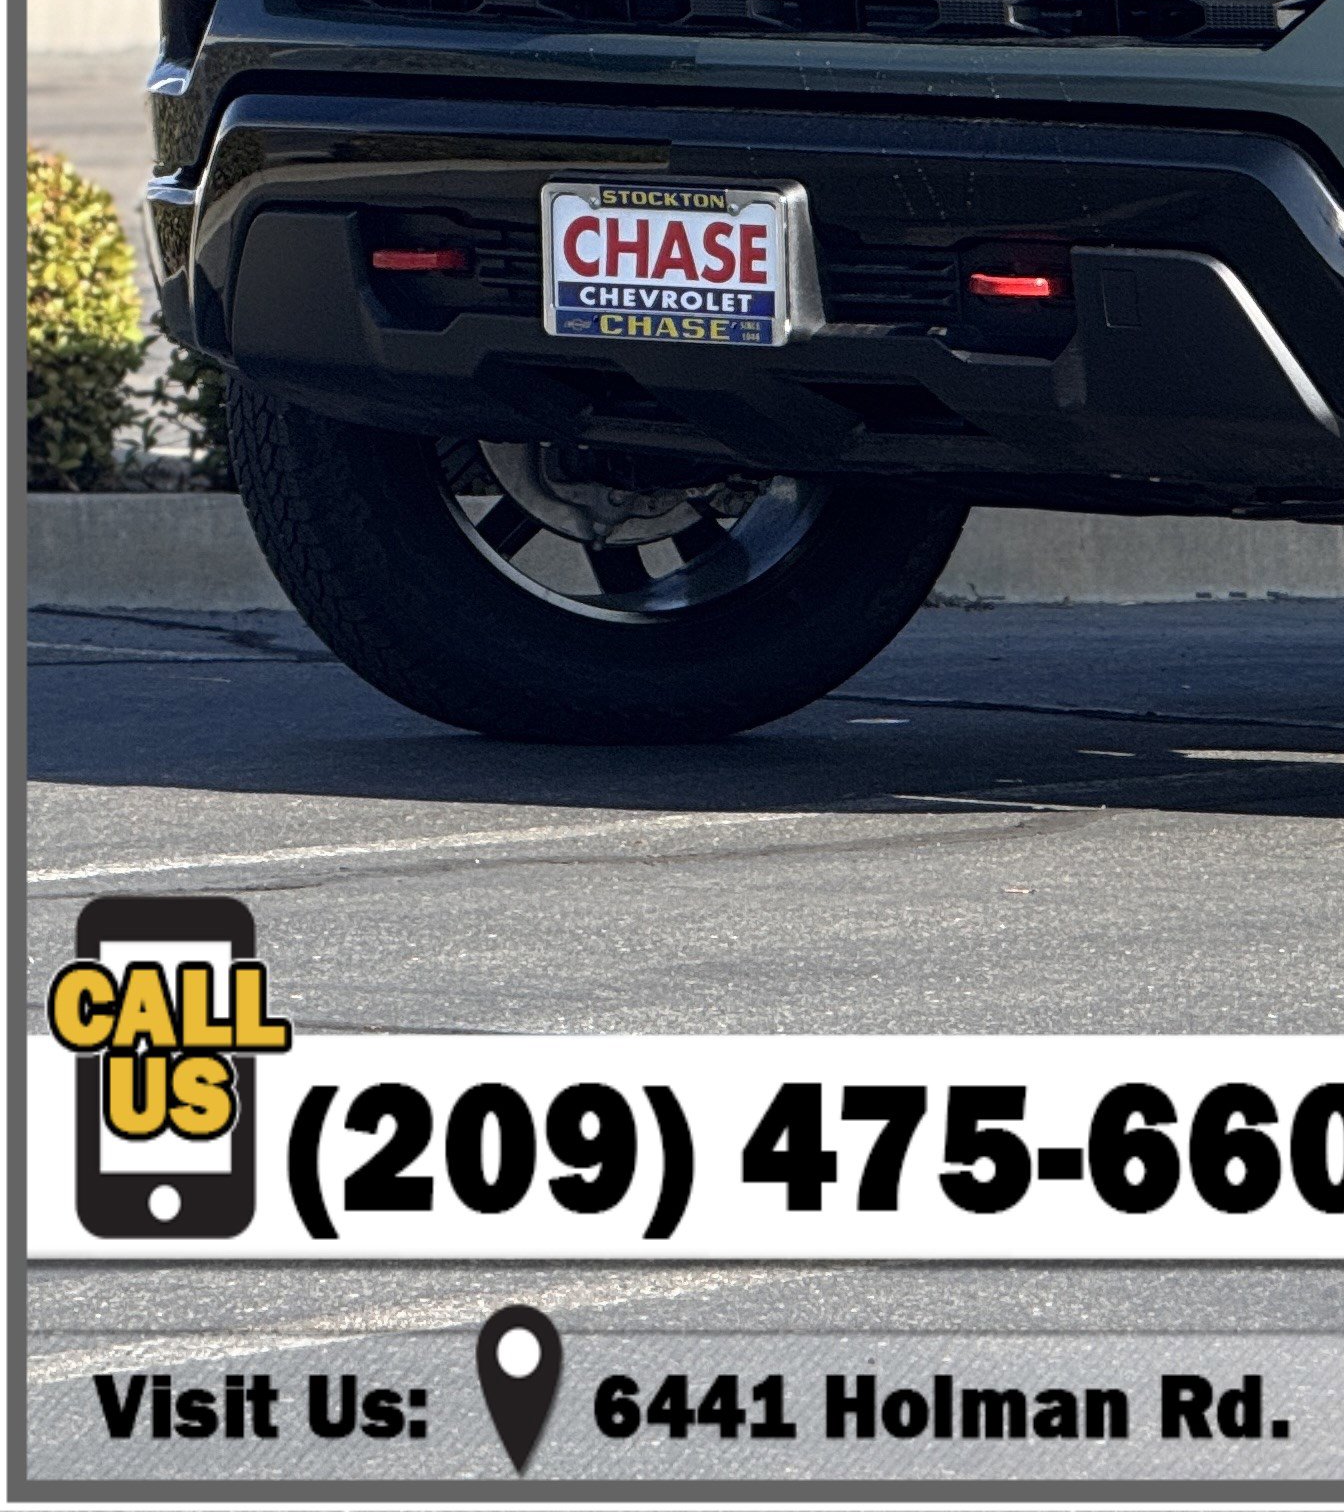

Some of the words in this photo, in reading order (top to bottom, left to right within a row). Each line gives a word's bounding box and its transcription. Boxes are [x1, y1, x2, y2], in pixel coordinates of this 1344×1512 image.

[602, 189, 725, 209] STOCKTON
[563, 215, 768, 284] CHASE
[579, 287, 753, 313] CHEVROLET
[600, 314, 730, 340] CHASE
